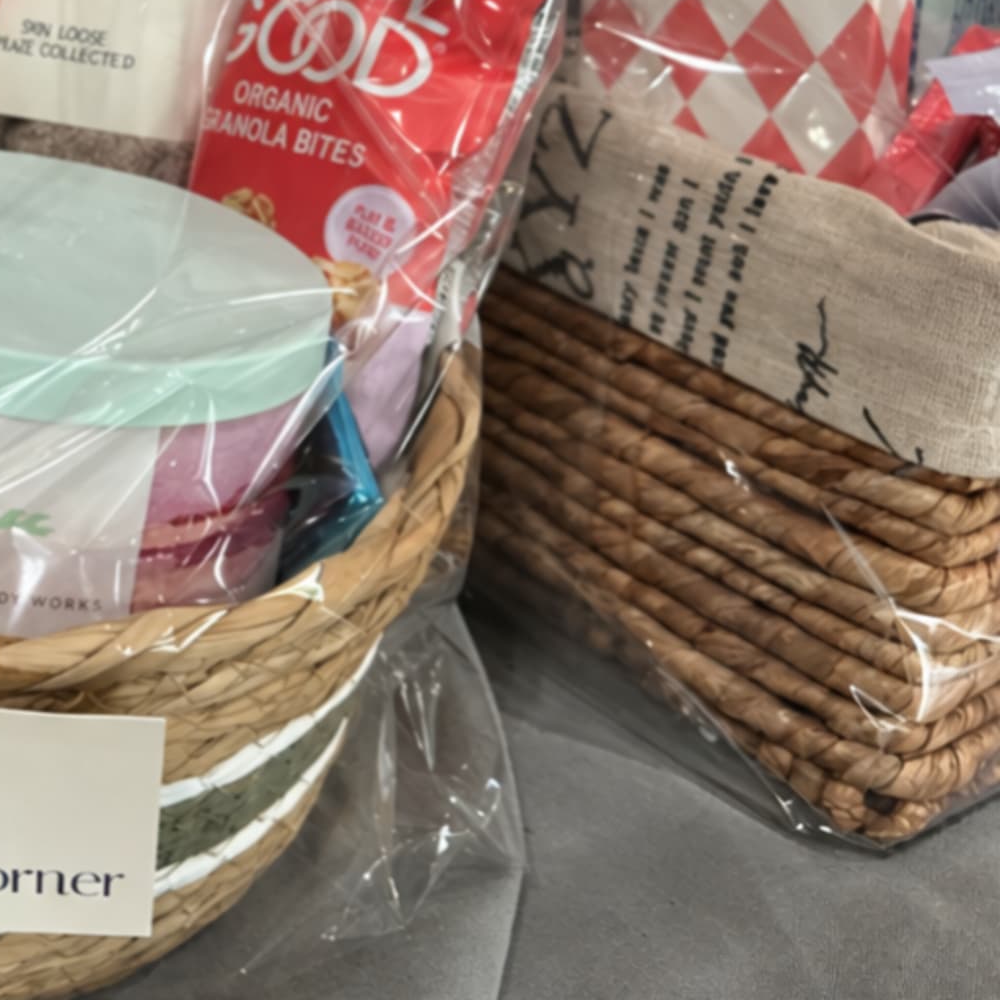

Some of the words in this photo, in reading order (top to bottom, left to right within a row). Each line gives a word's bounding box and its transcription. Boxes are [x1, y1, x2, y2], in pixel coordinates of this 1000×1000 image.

[233, 79, 333, 124] ORGANIC
[293, 128, 366, 169] BITES
[31, 593, 104, 613] WORKS
